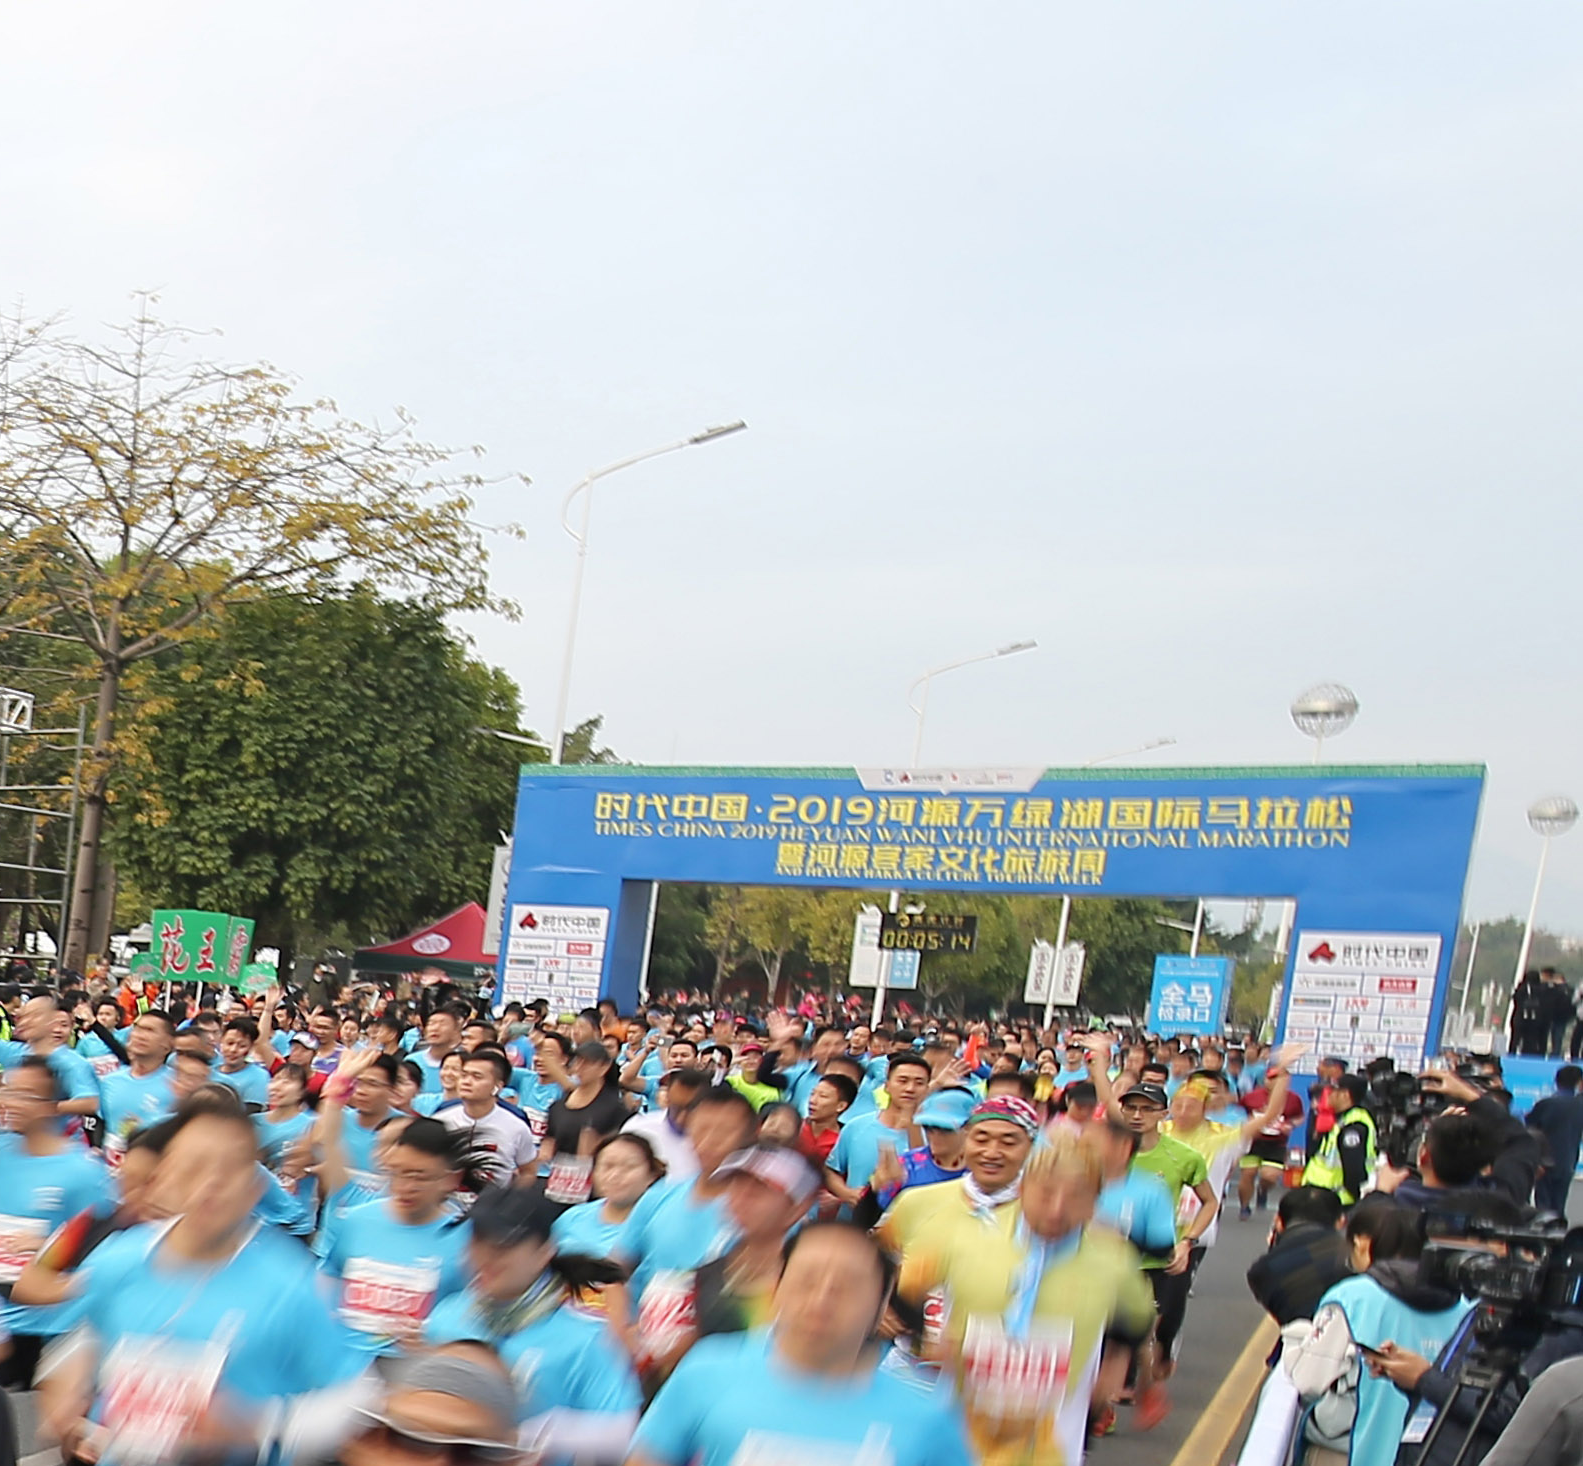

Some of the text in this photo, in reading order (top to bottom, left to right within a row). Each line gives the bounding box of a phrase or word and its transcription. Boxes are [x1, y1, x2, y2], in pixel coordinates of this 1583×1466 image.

[594, 820, 1350, 849] TIMES CHINA 2019 HEYUAN WANLVHU INTERNATIONAL MARATHON
